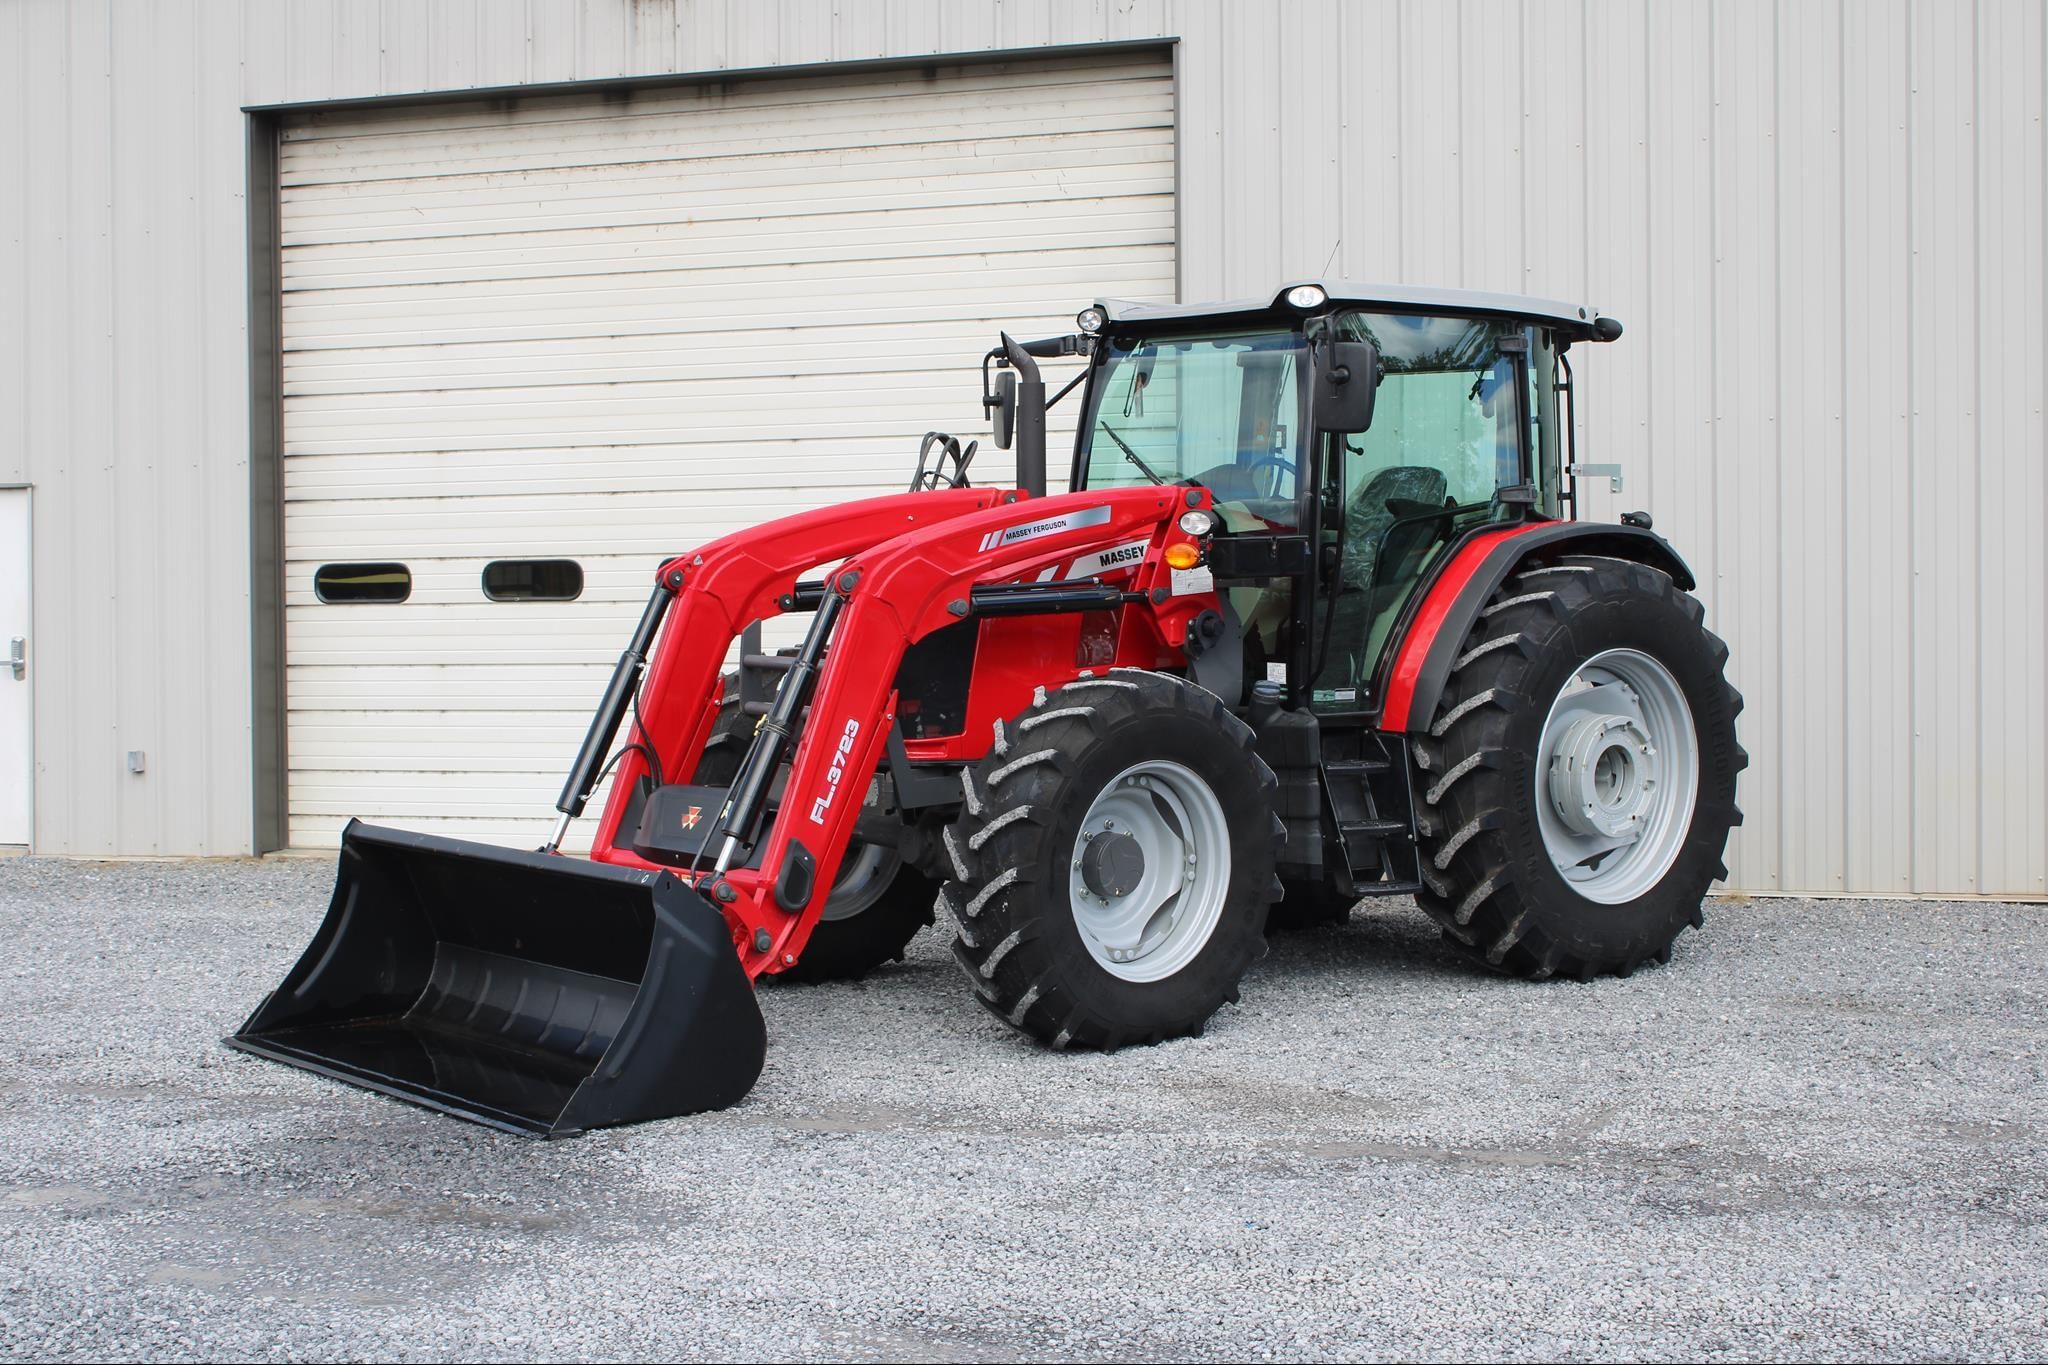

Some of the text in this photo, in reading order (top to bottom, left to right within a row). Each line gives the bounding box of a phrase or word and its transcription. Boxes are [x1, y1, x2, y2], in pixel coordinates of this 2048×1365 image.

[1006, 520, 1067, 540] MASSEY FERGUSON
[1099, 545, 1145, 567] MASSEY
